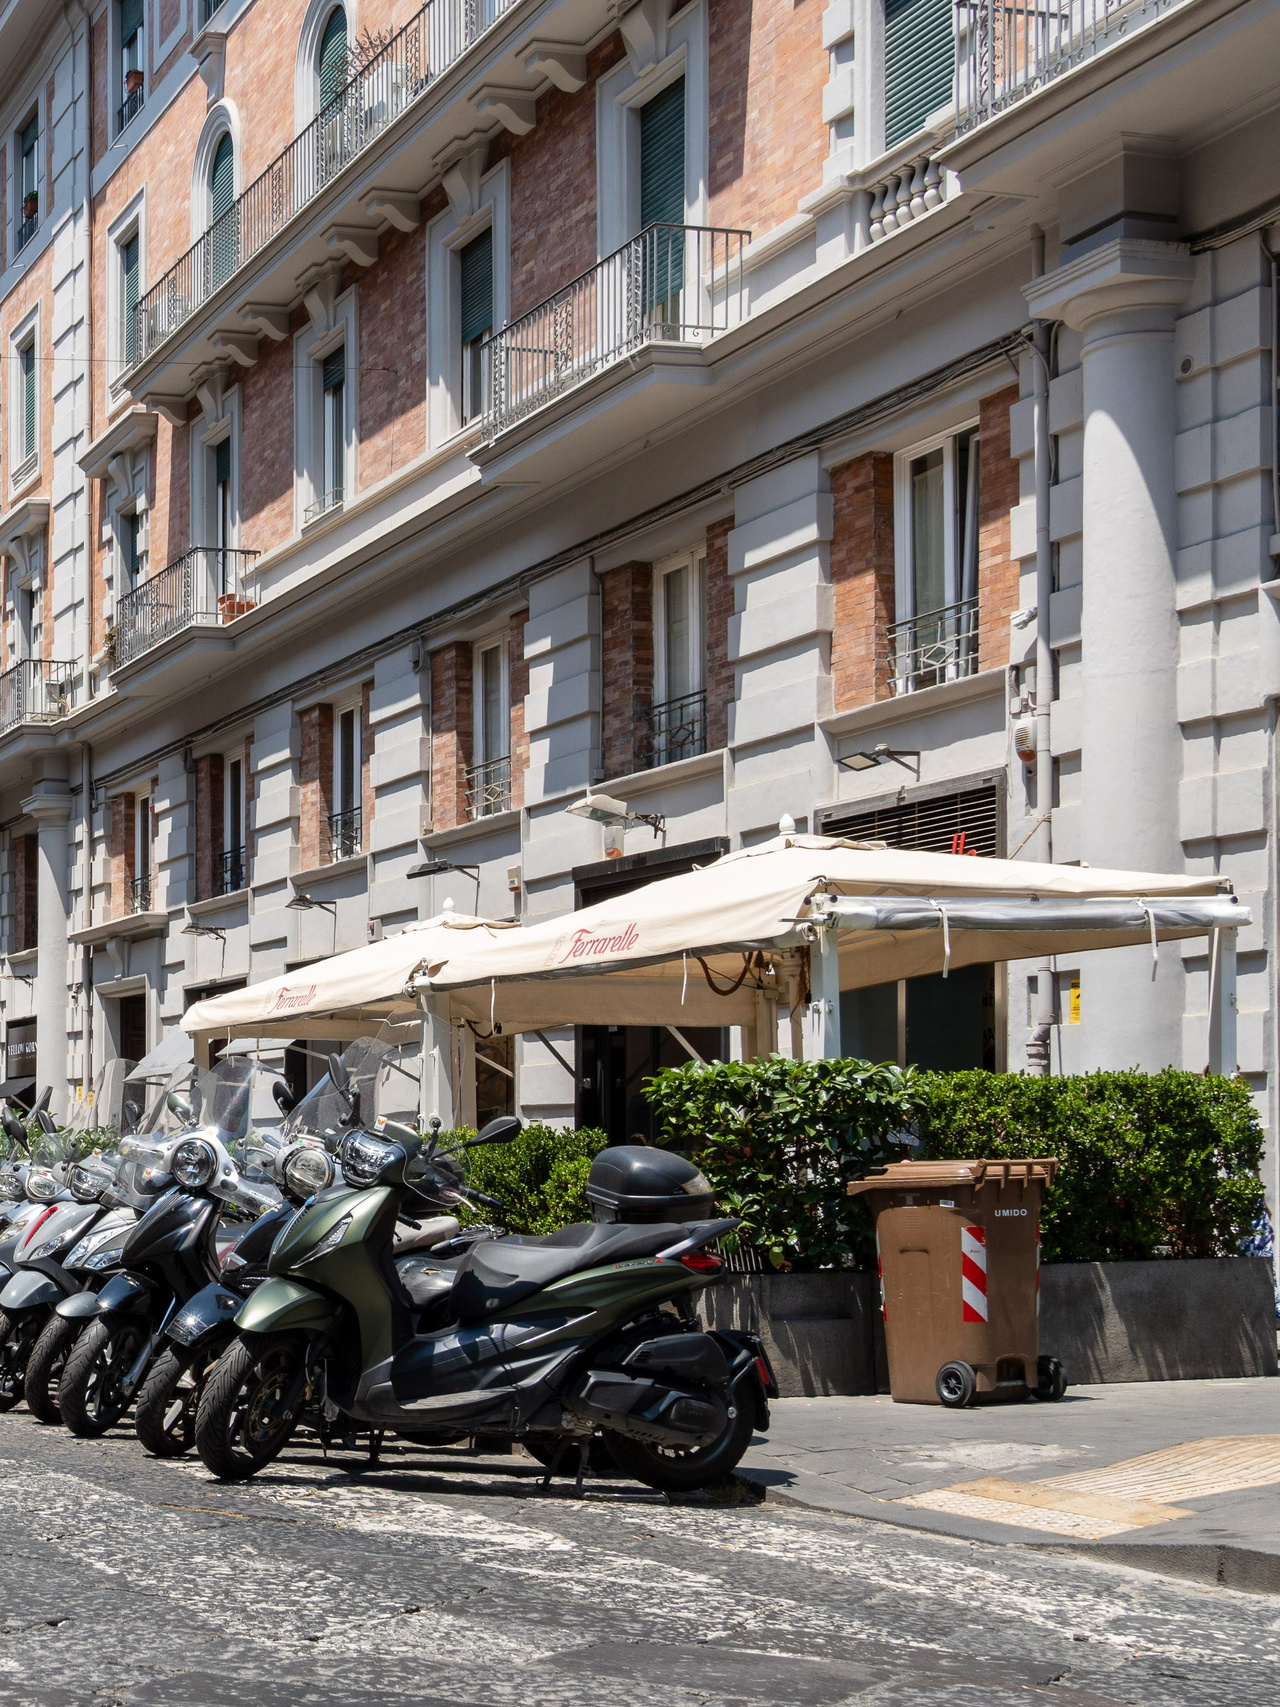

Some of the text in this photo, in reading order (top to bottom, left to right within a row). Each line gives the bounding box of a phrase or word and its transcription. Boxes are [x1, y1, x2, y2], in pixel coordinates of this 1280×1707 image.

[558, 922, 639, 964] Ferrarelle
[267, 985, 317, 1014] Ferrarelle
[994, 1208, 1028, 1217] UMIDO
